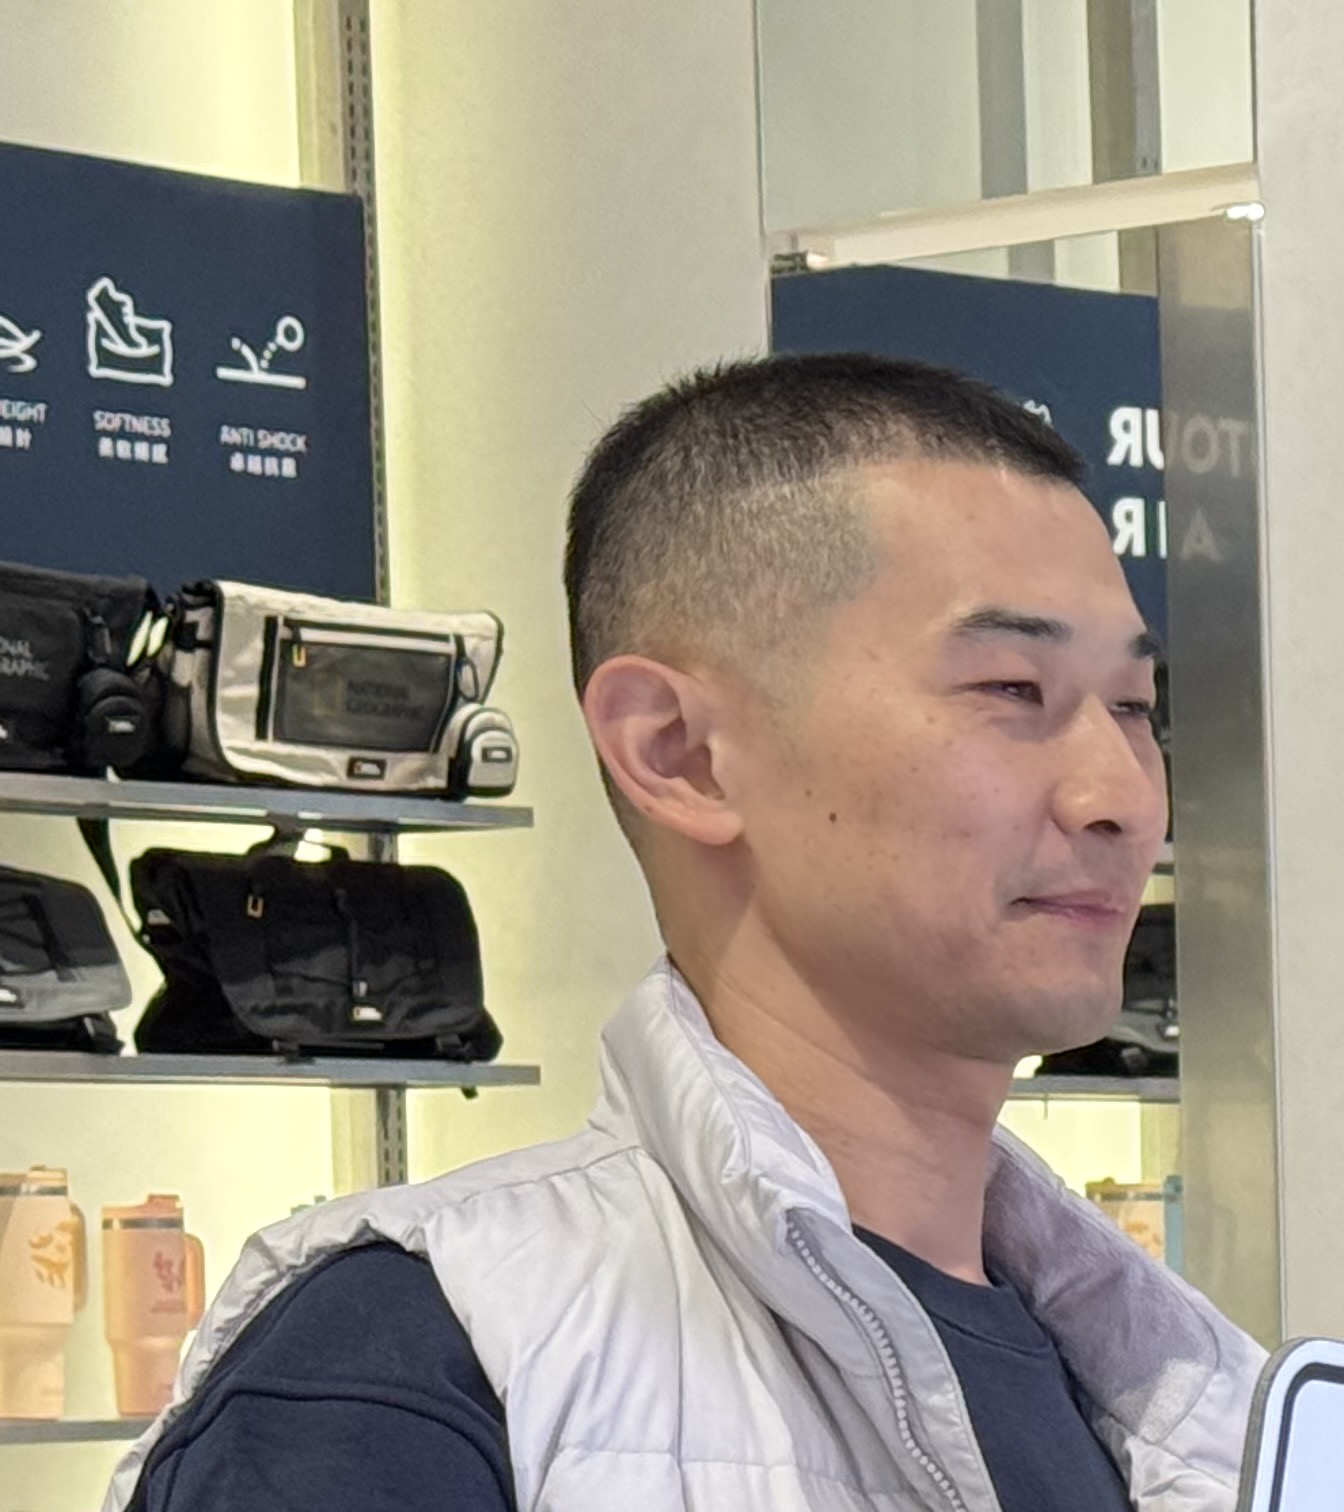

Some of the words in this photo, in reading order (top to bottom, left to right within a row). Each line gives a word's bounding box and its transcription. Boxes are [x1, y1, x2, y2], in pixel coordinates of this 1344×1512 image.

[93, 410, 171, 438] SOFTNESS
[220, 425, 254, 447] ANTI
[257, 429, 308, 453] SHOCK
